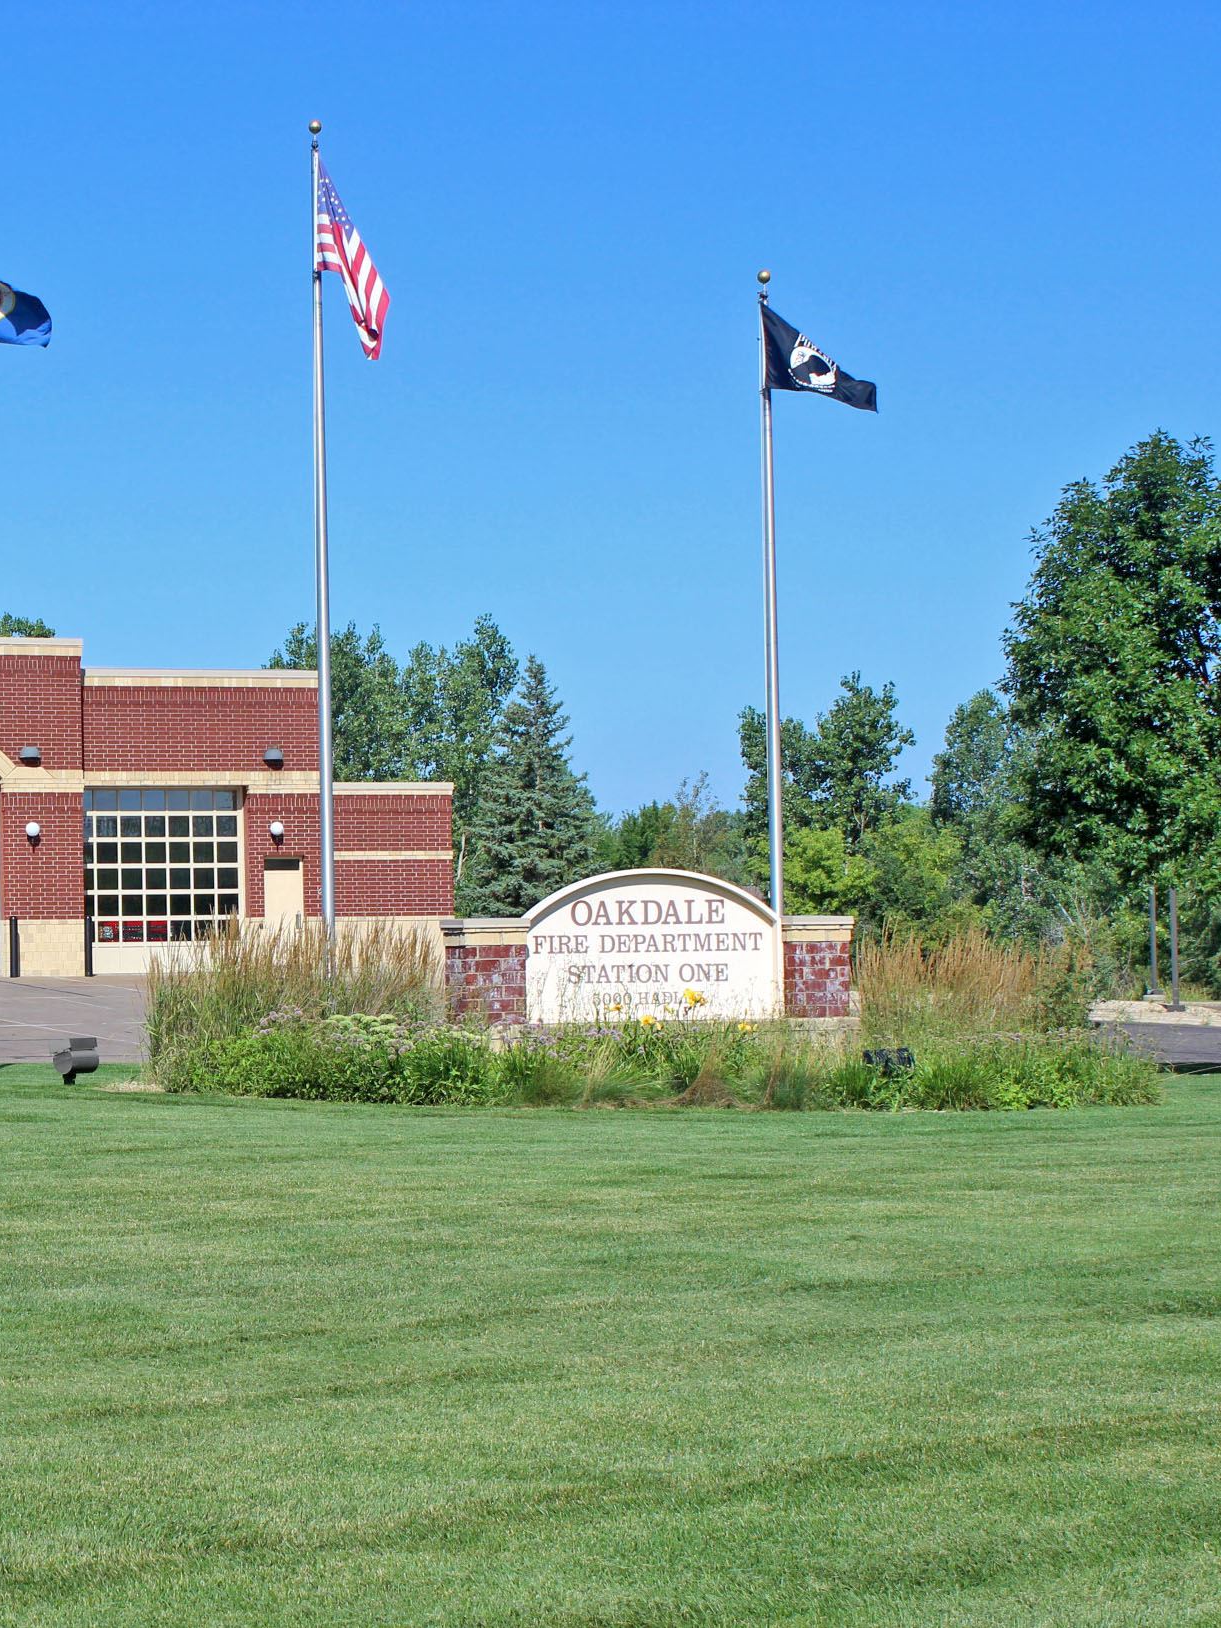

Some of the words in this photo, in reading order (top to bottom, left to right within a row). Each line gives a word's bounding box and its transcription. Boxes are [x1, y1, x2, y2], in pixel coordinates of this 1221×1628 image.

[570, 899, 725, 926] OAKDALE
[533, 935, 589, 955] FIRE
[599, 932, 763, 953] DEPARTMENT
[568, 964, 669, 984] STATION
[679, 963, 729, 982] ONE
